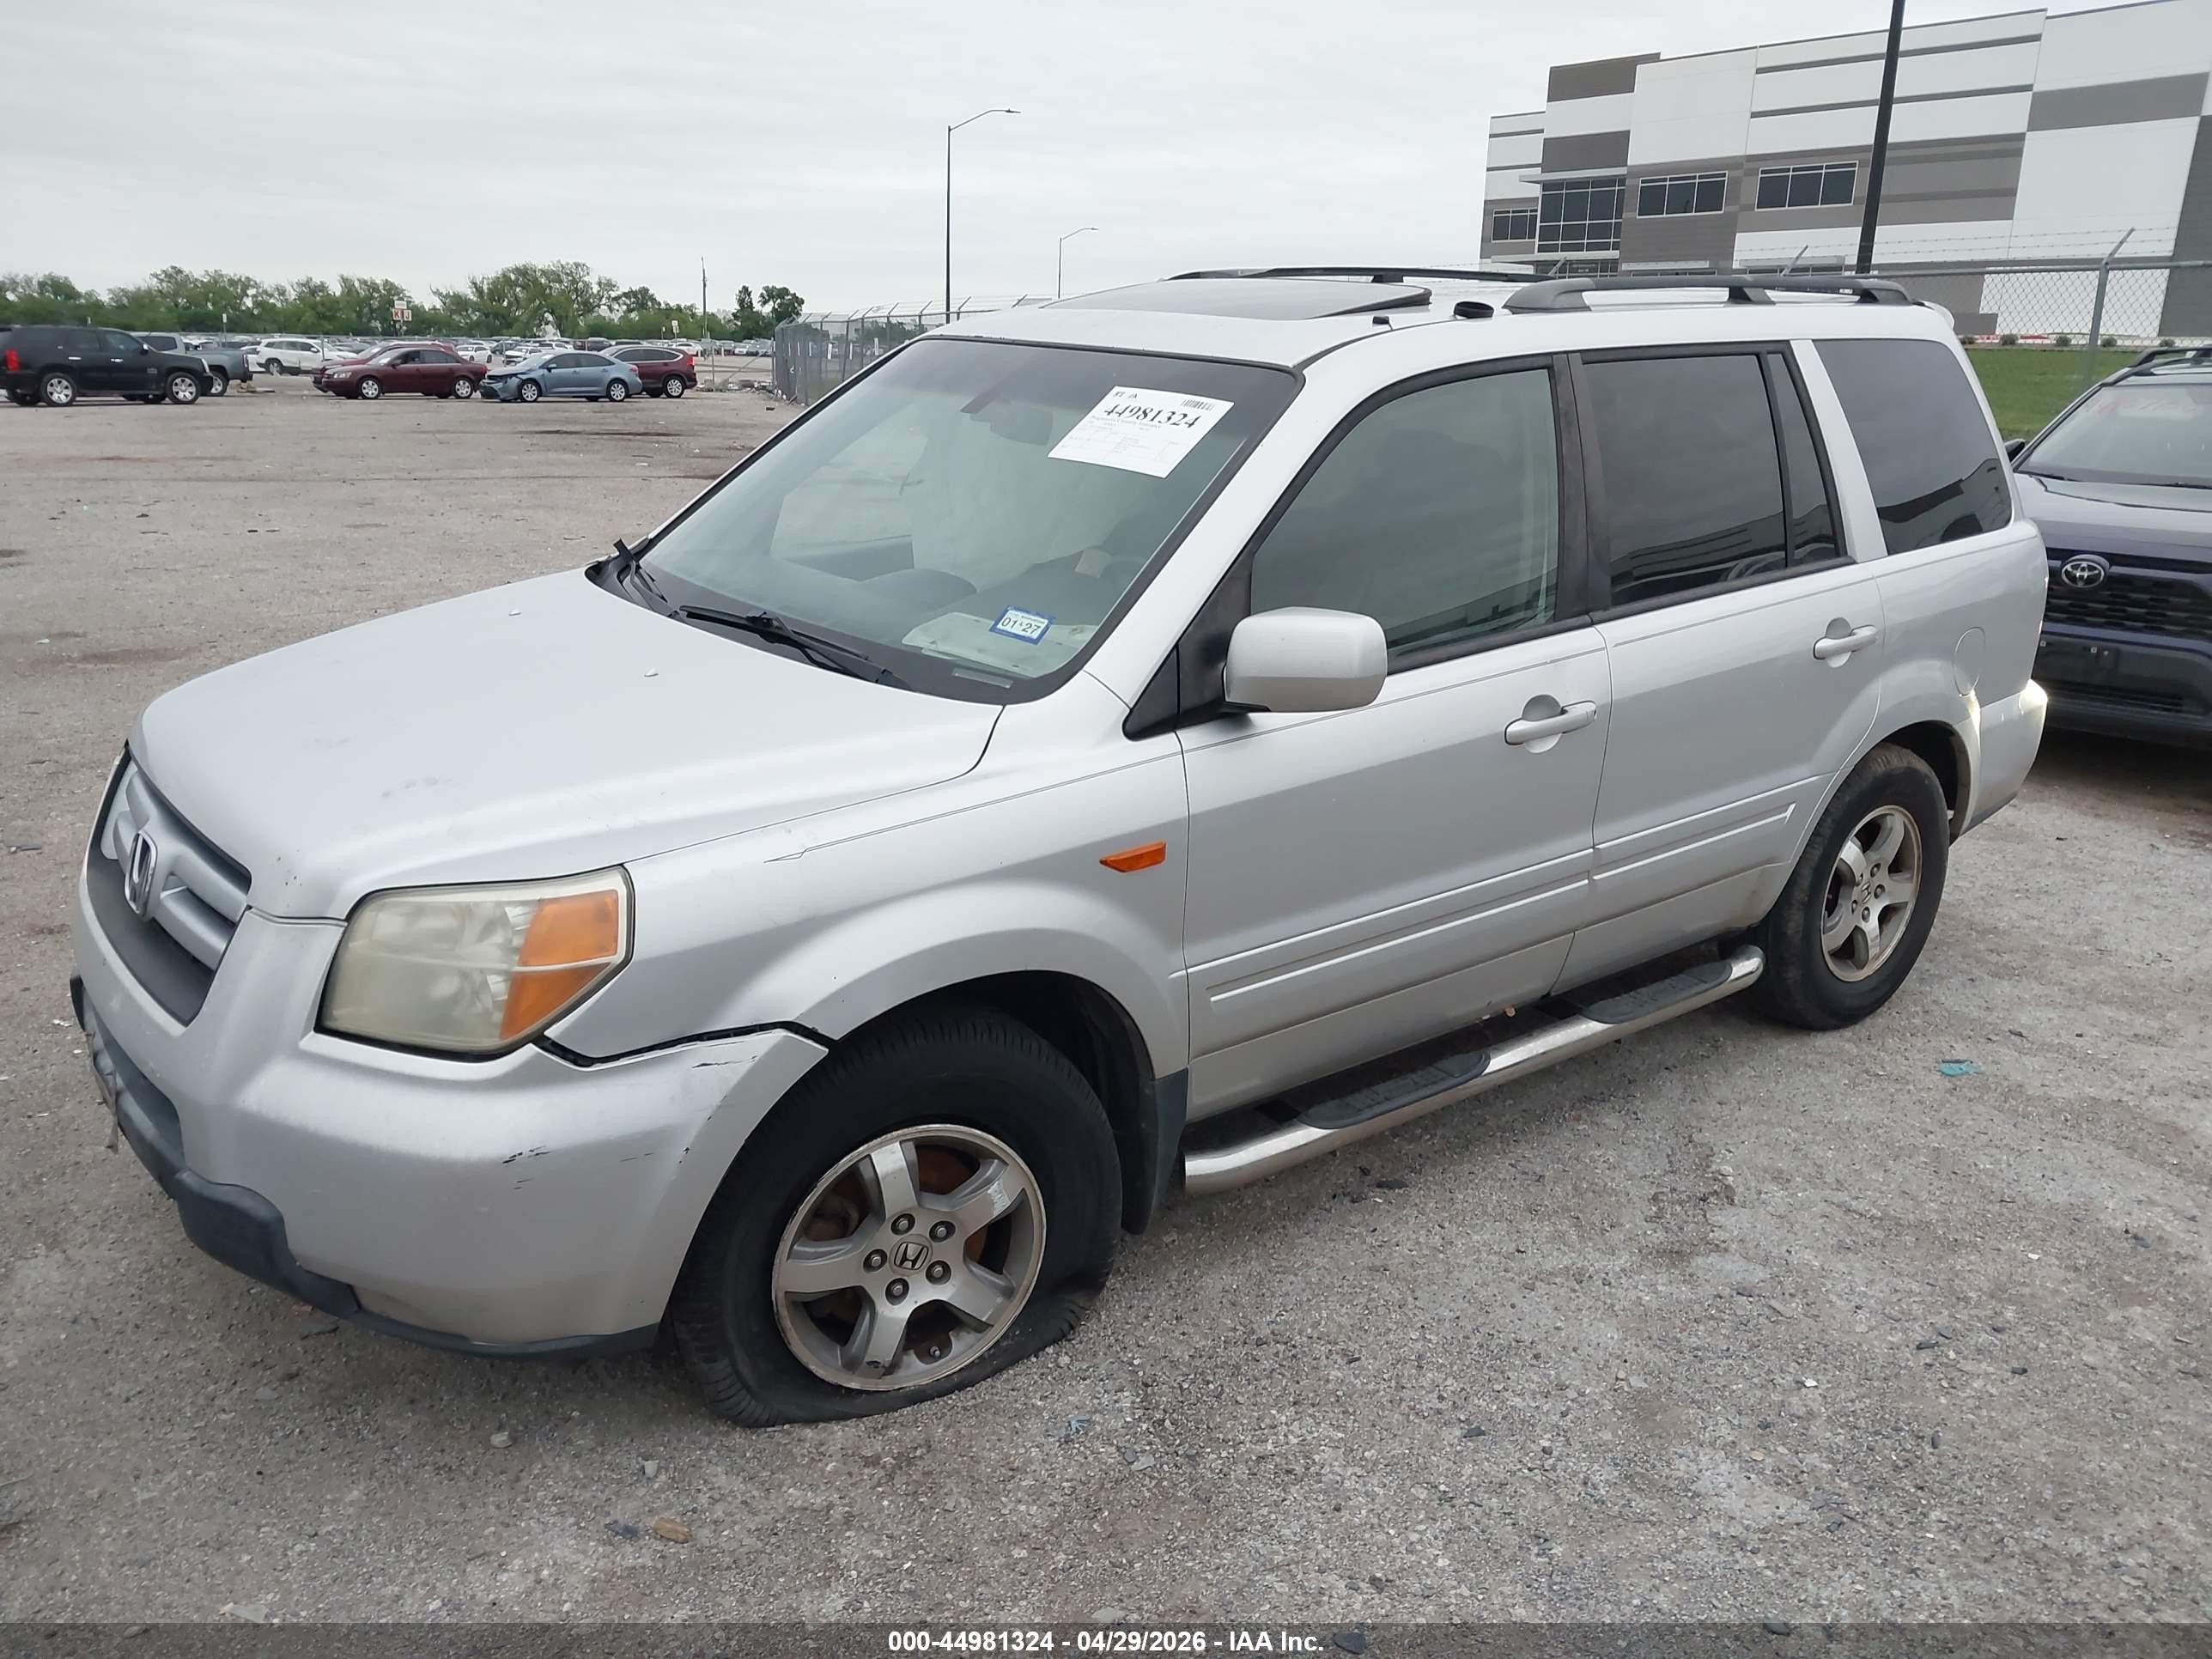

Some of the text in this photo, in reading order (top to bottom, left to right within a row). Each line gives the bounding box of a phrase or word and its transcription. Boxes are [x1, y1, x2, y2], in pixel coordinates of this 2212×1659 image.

[1103, 403, 1201, 428] 44981324
[1001, 617, 1018, 629] 01
[1021, 623, 1042, 635] 27
